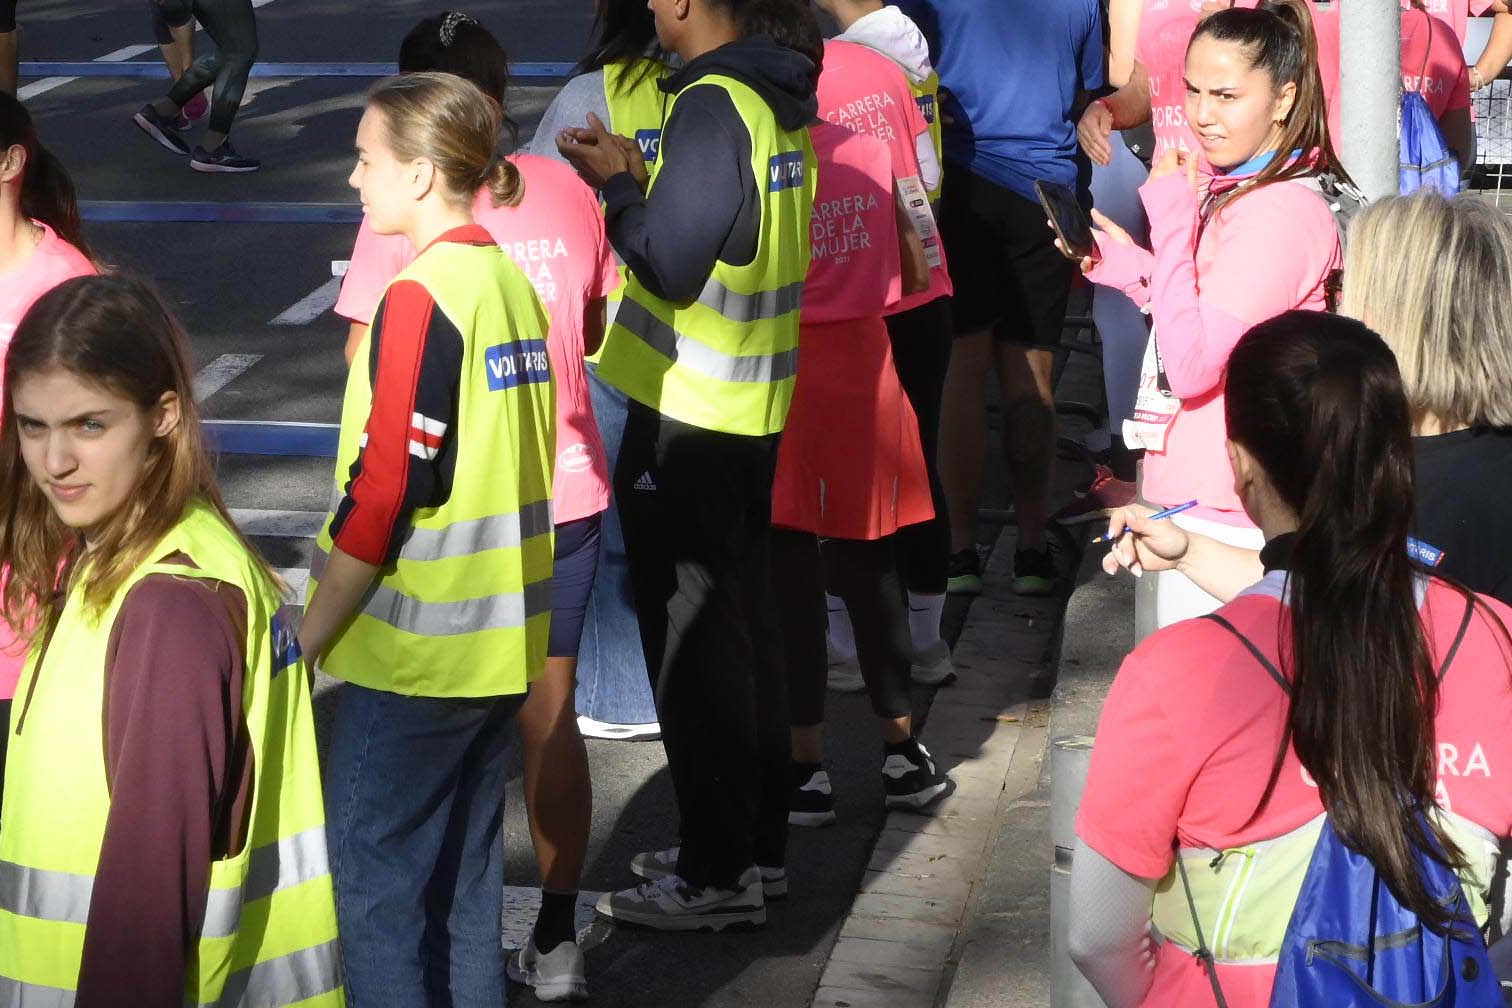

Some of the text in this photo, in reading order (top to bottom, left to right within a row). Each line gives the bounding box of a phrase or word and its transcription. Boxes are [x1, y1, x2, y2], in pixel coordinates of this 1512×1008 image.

[826, 91, 895, 126] CARRERA
[867, 110, 889, 129] LA
[812, 214, 865, 241] DE LA
[811, 232, 872, 260] MUJER
[634, 483, 657, 491] adidas
